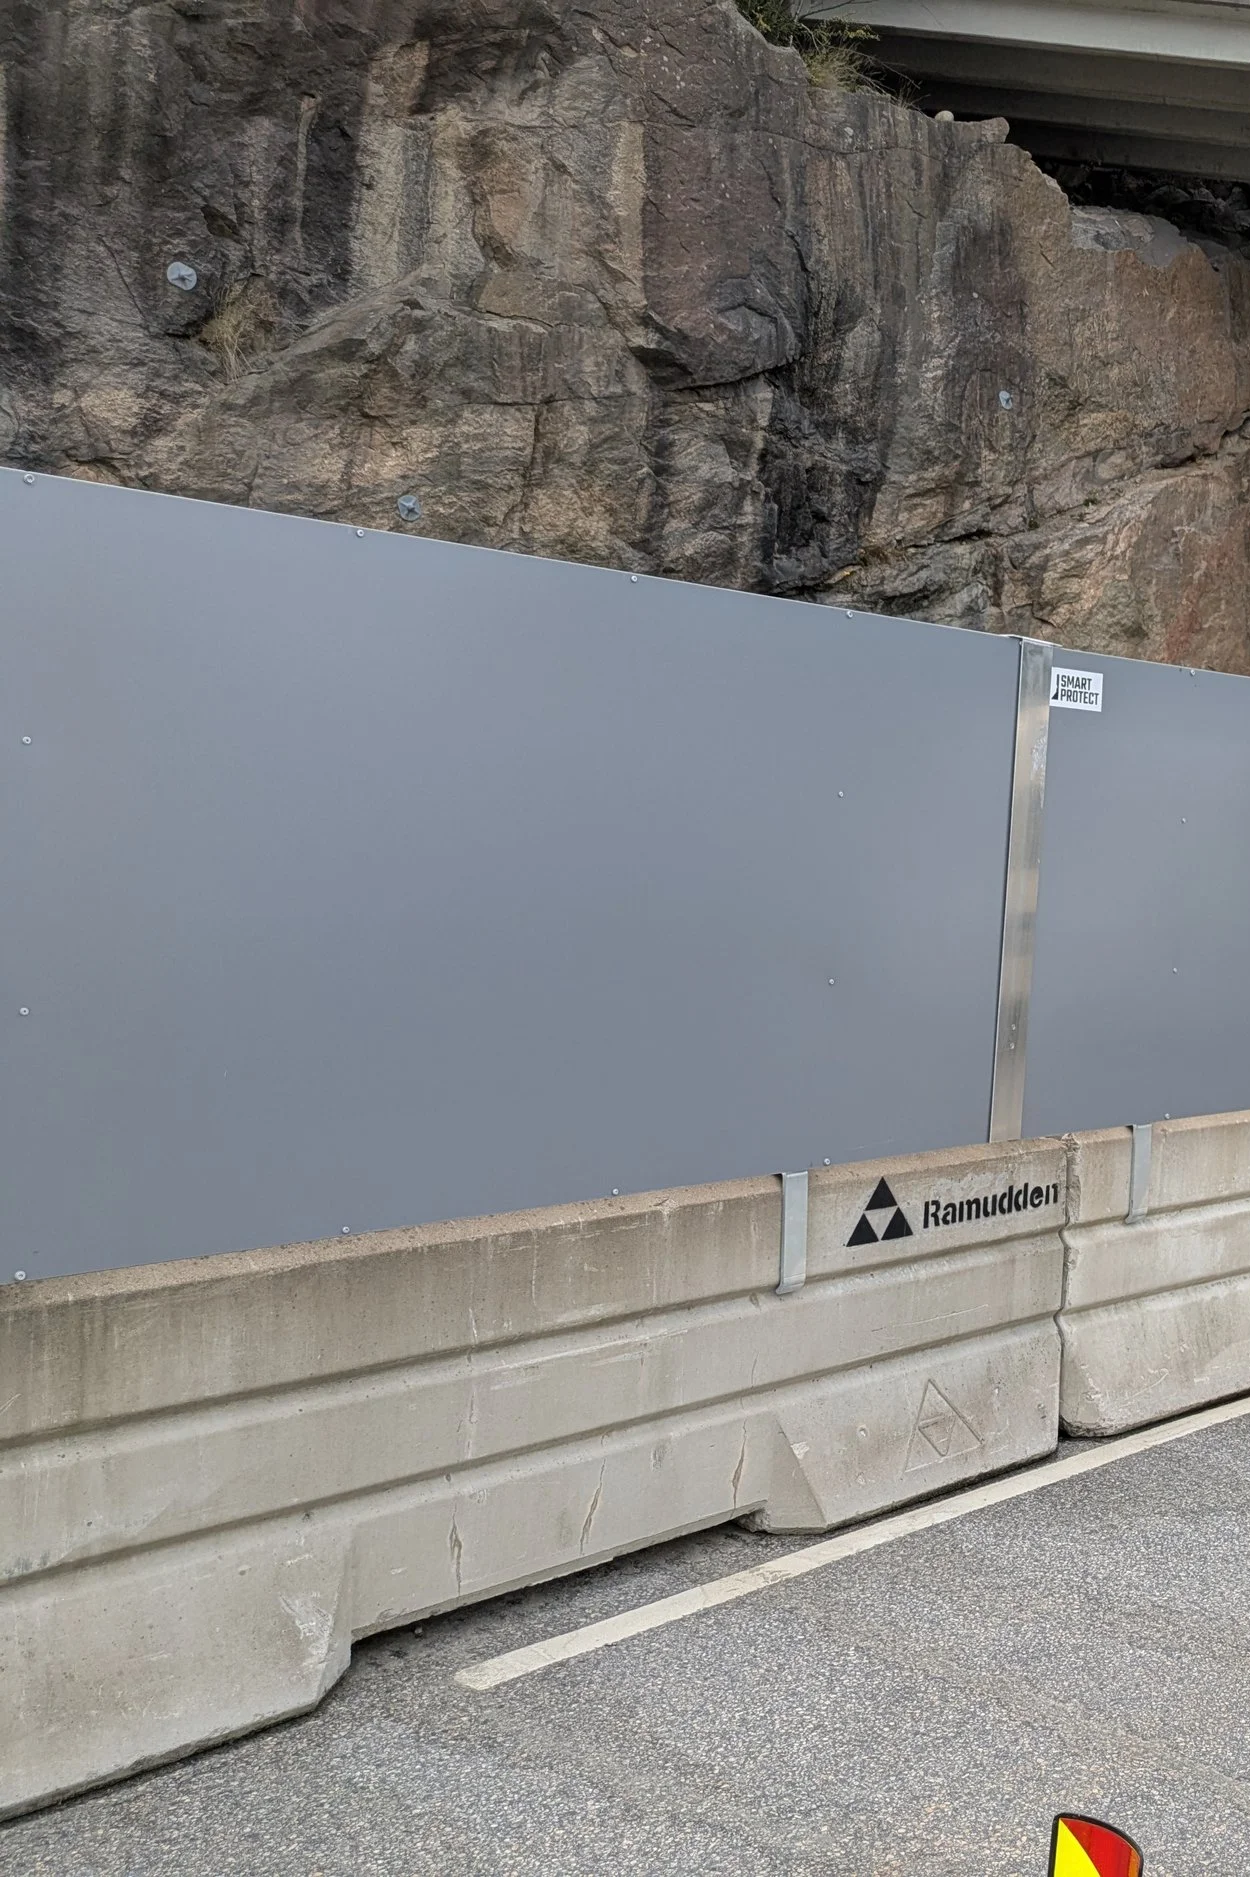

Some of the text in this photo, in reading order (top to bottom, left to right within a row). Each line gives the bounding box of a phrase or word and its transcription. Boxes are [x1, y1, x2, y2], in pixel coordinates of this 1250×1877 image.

[1060, 674, 1092, 691] SMART
[1060, 688, 1100, 706] PROTECT
[923, 1182, 1059, 1229] Ramudden
